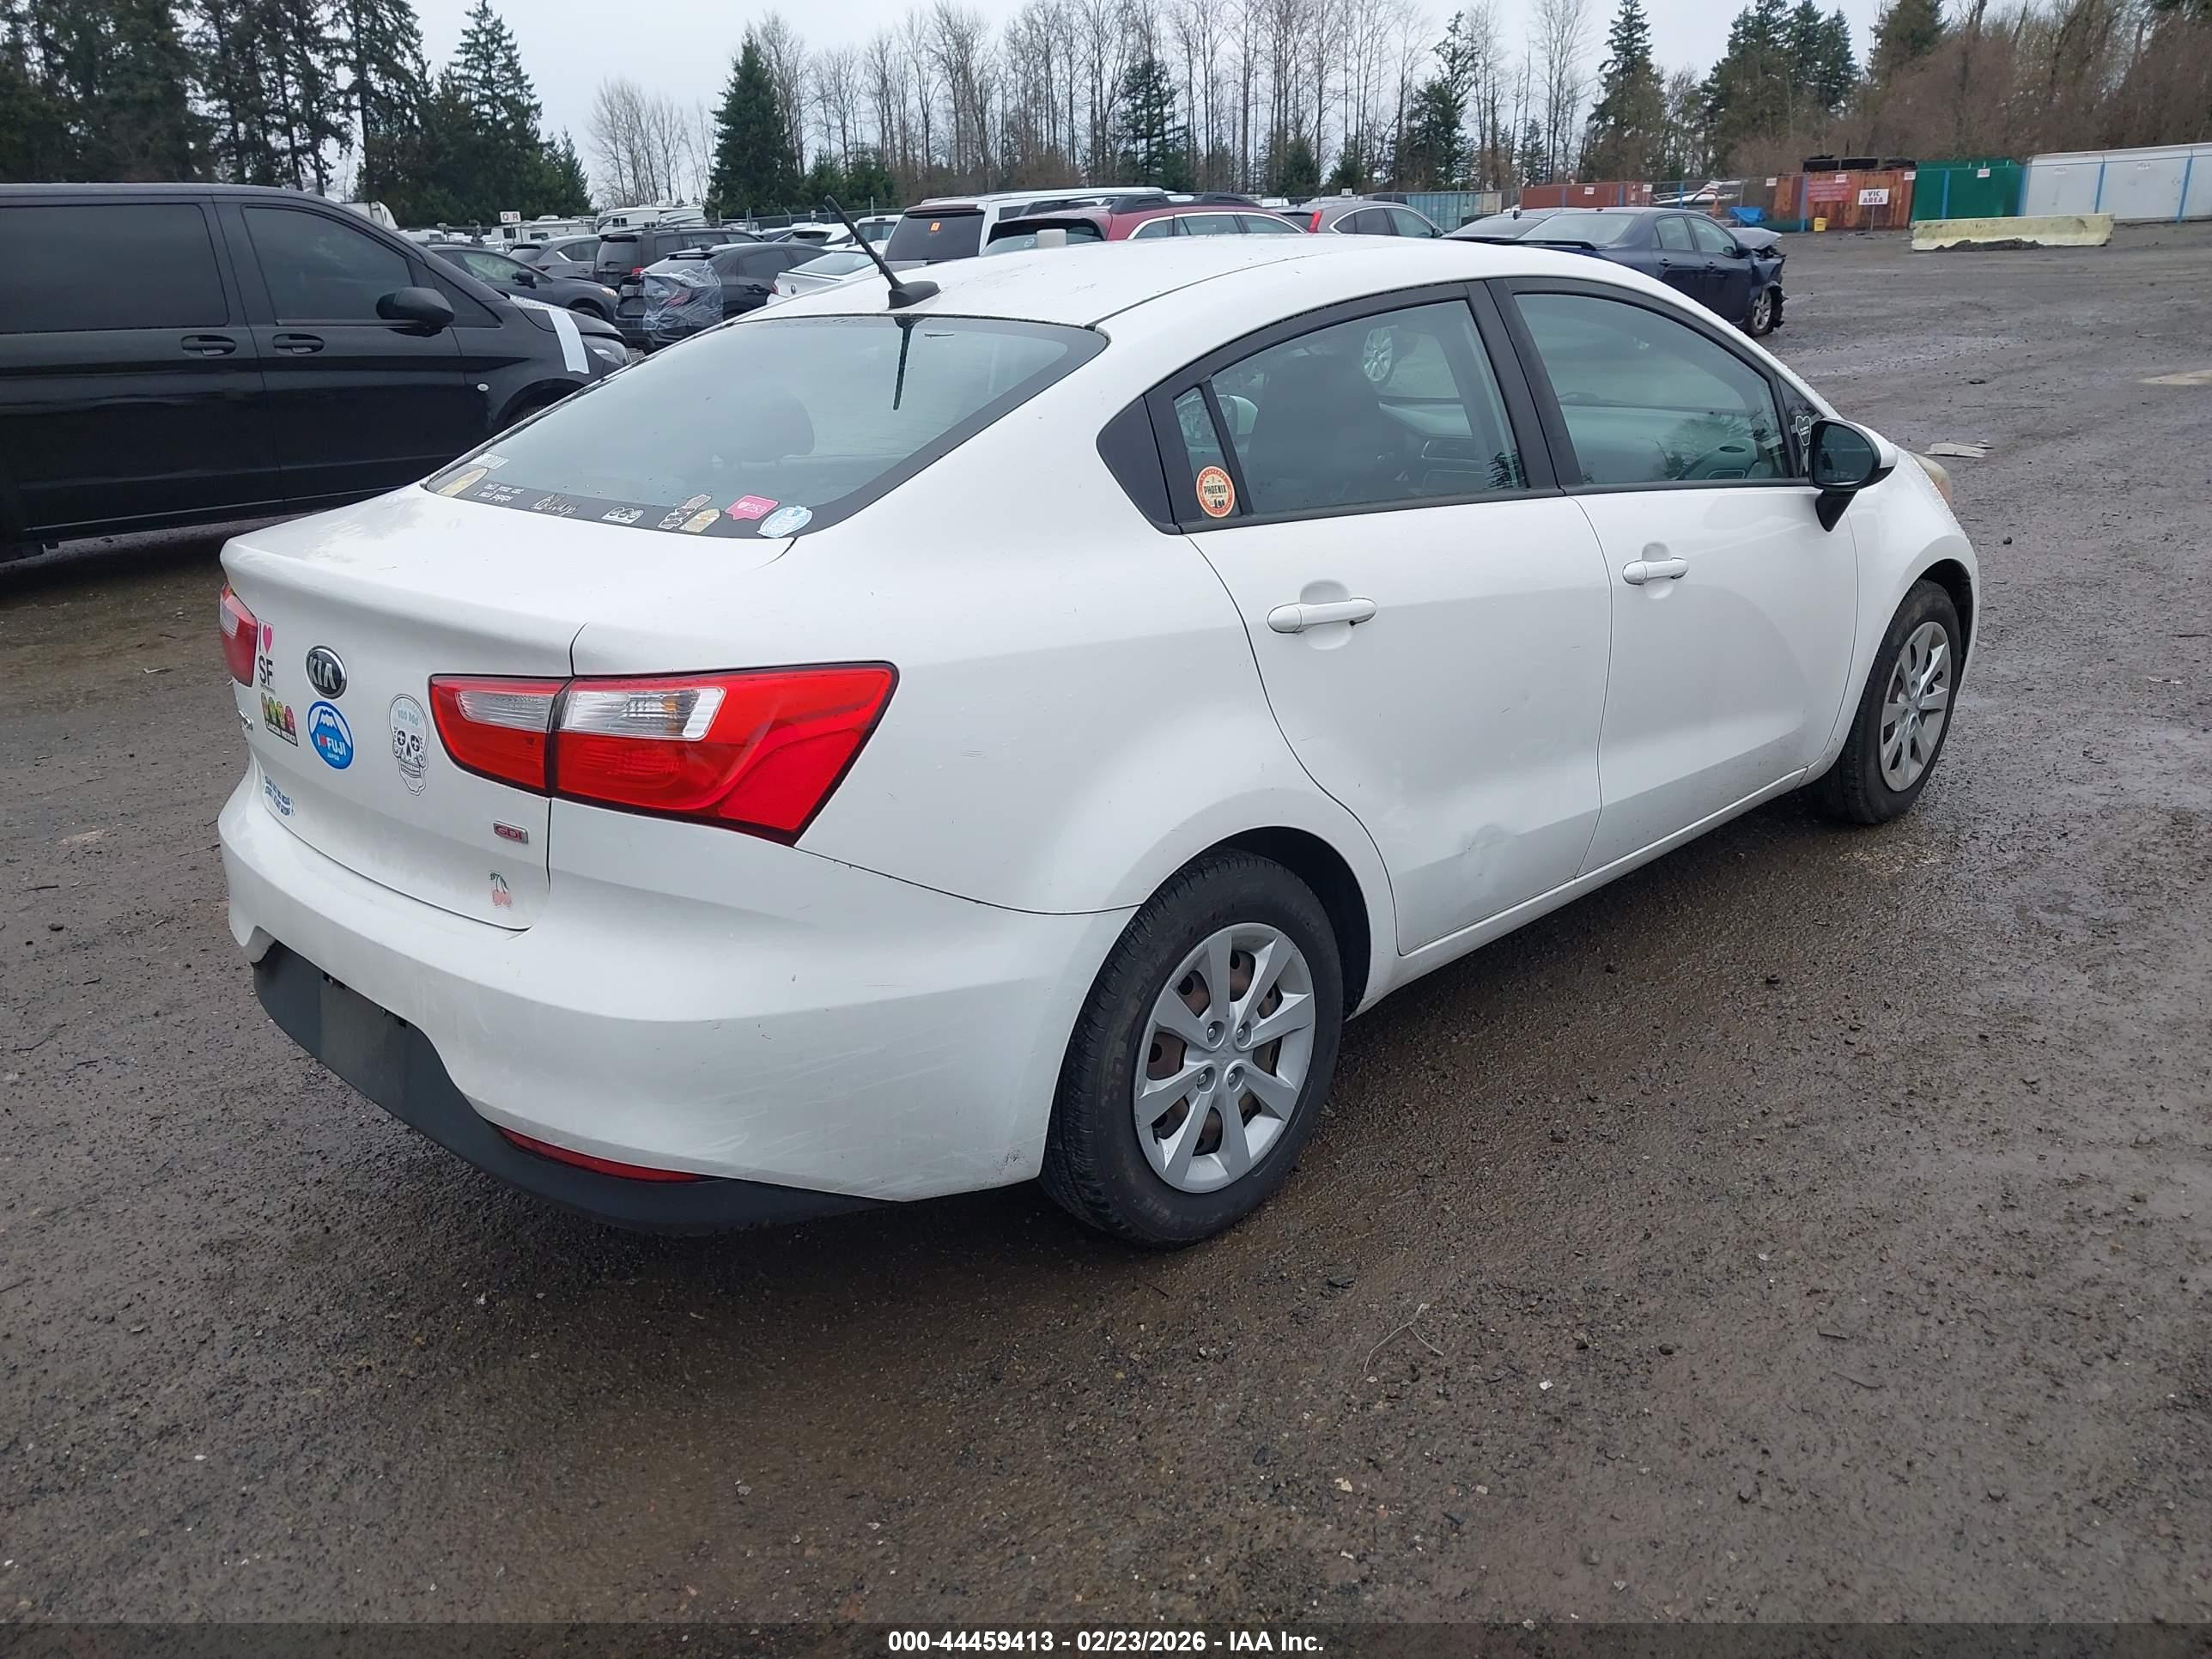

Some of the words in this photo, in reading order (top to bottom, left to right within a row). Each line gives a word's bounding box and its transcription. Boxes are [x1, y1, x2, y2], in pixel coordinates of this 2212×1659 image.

[1203, 484, 1227, 495] PHOENIX
[258, 655, 274, 687] SF
[308, 656, 337, 690] KIA
[326, 737, 347, 757] FUJI
[495, 825, 523, 841] GDI
